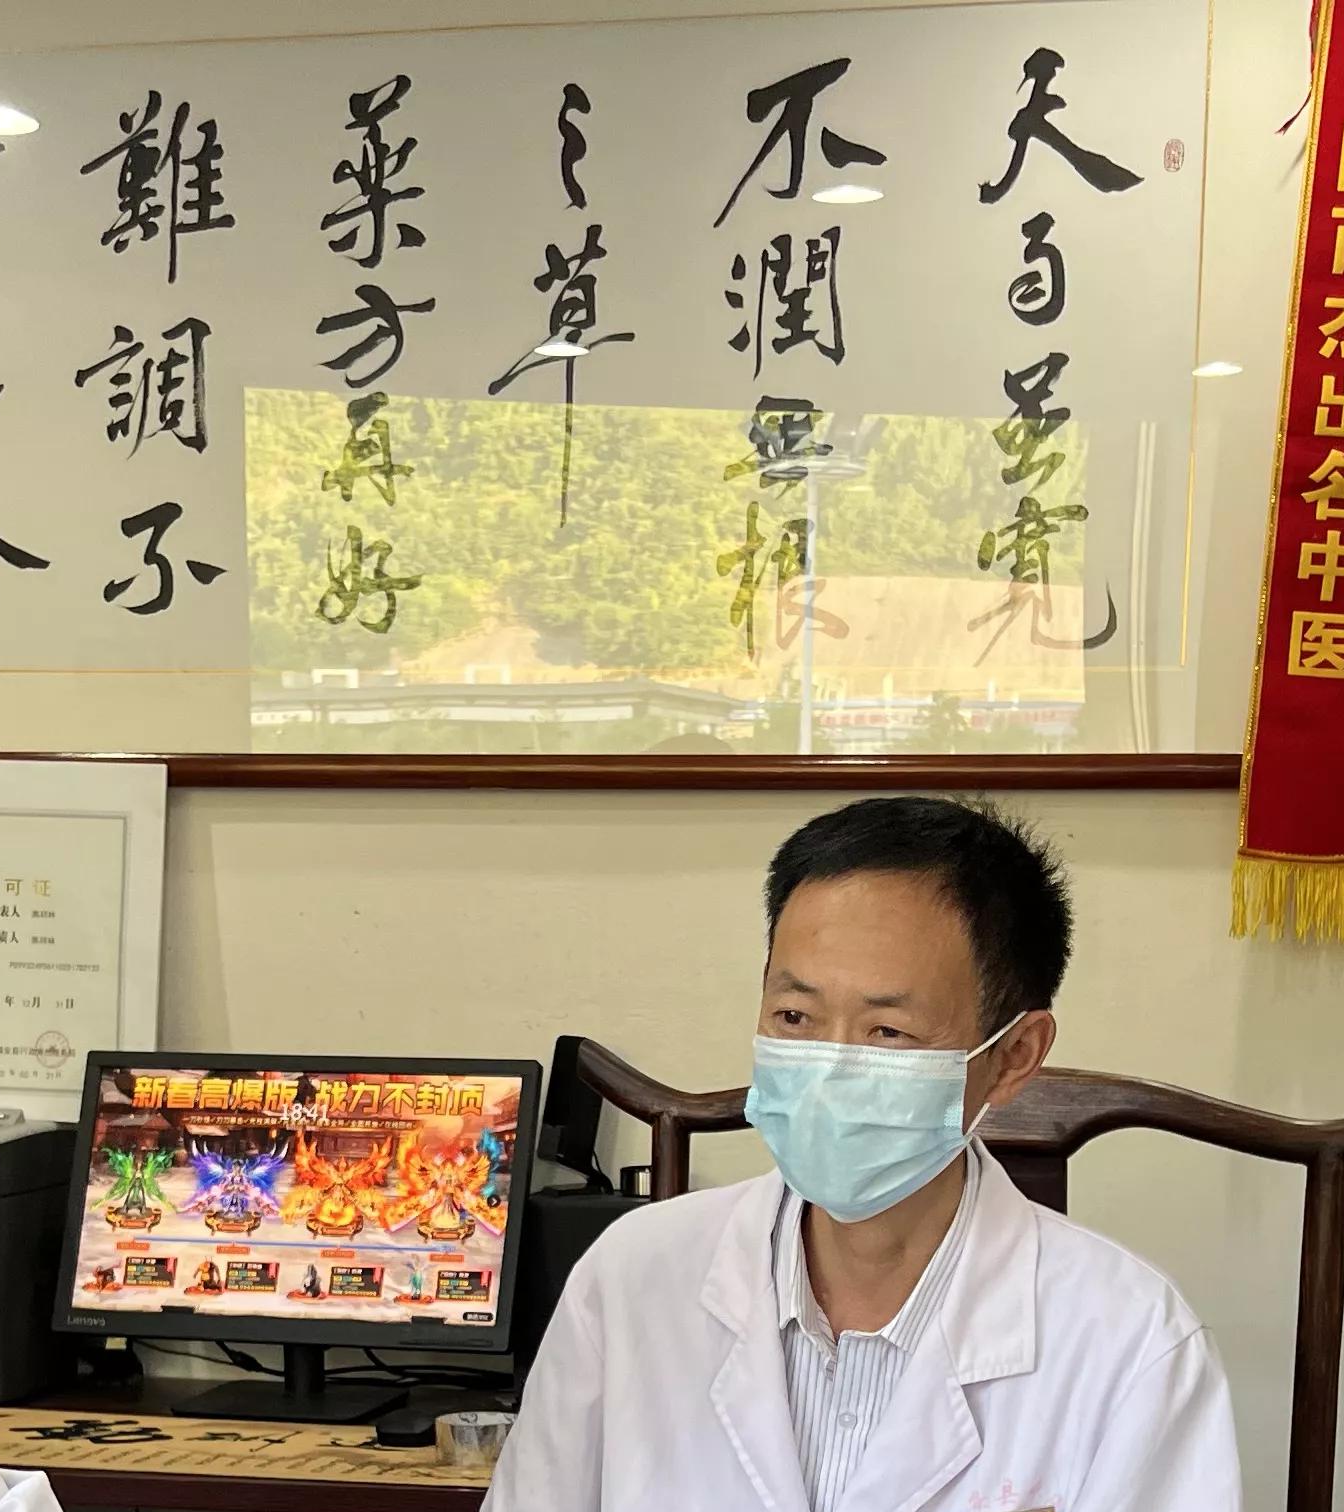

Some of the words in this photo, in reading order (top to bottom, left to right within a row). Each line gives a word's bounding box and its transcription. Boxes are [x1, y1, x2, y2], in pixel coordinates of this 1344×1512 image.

[316, 1080, 485, 1117] 战力不封顶
